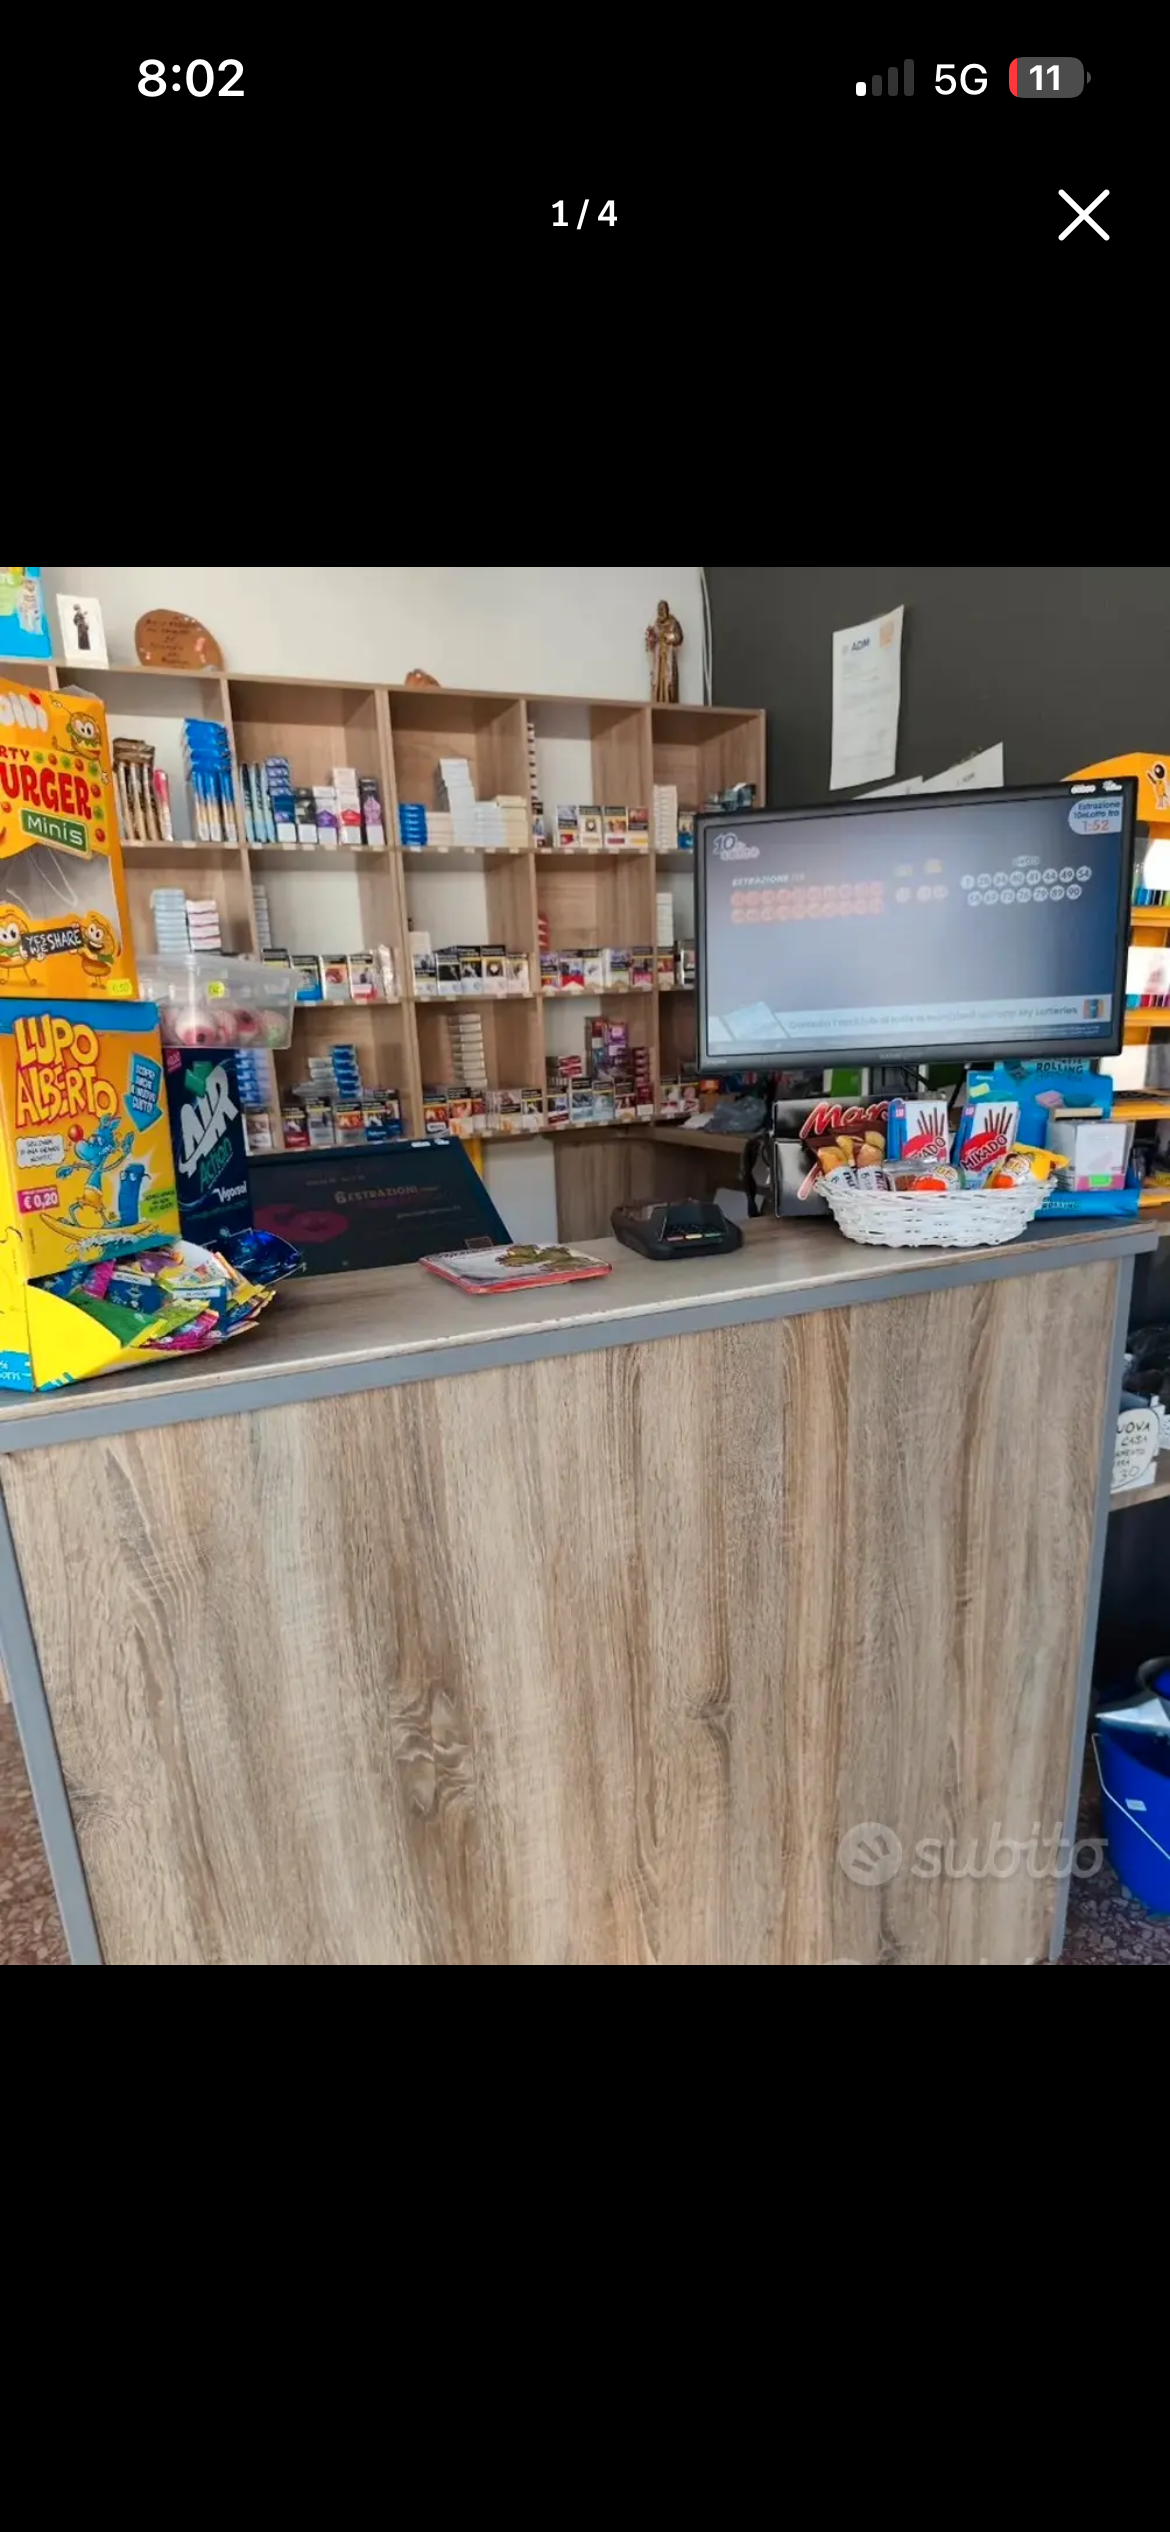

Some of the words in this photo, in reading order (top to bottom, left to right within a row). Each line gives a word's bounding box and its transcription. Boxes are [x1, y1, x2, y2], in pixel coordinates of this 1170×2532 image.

[851, 637, 871, 652] ADM
[0, 762, 93, 820] URGER
[27, 815, 84, 846] Minis
[1081, 820, 1109, 832] 1:52
[714, 834, 737, 852] 10
[732, 875, 789, 887] ESTRAZIONE
[46, 929, 82, 950] SHARE
[1035, 1005, 1078, 1017] Lotteries
[15, 1014, 99, 1067] LUPO
[1036, 1061, 1083, 1074] ROLLING
[16, 1065, 118, 1128] ALBERTO
[961, 1134, 1008, 1171] MIKADO
[200, 1137, 232, 1192] Action
[33, 1192, 58, 1210] 0,20
[212, 1181, 248, 1202] Vigorsol
[347, 1185, 418, 1202] ESTRAZIONI
